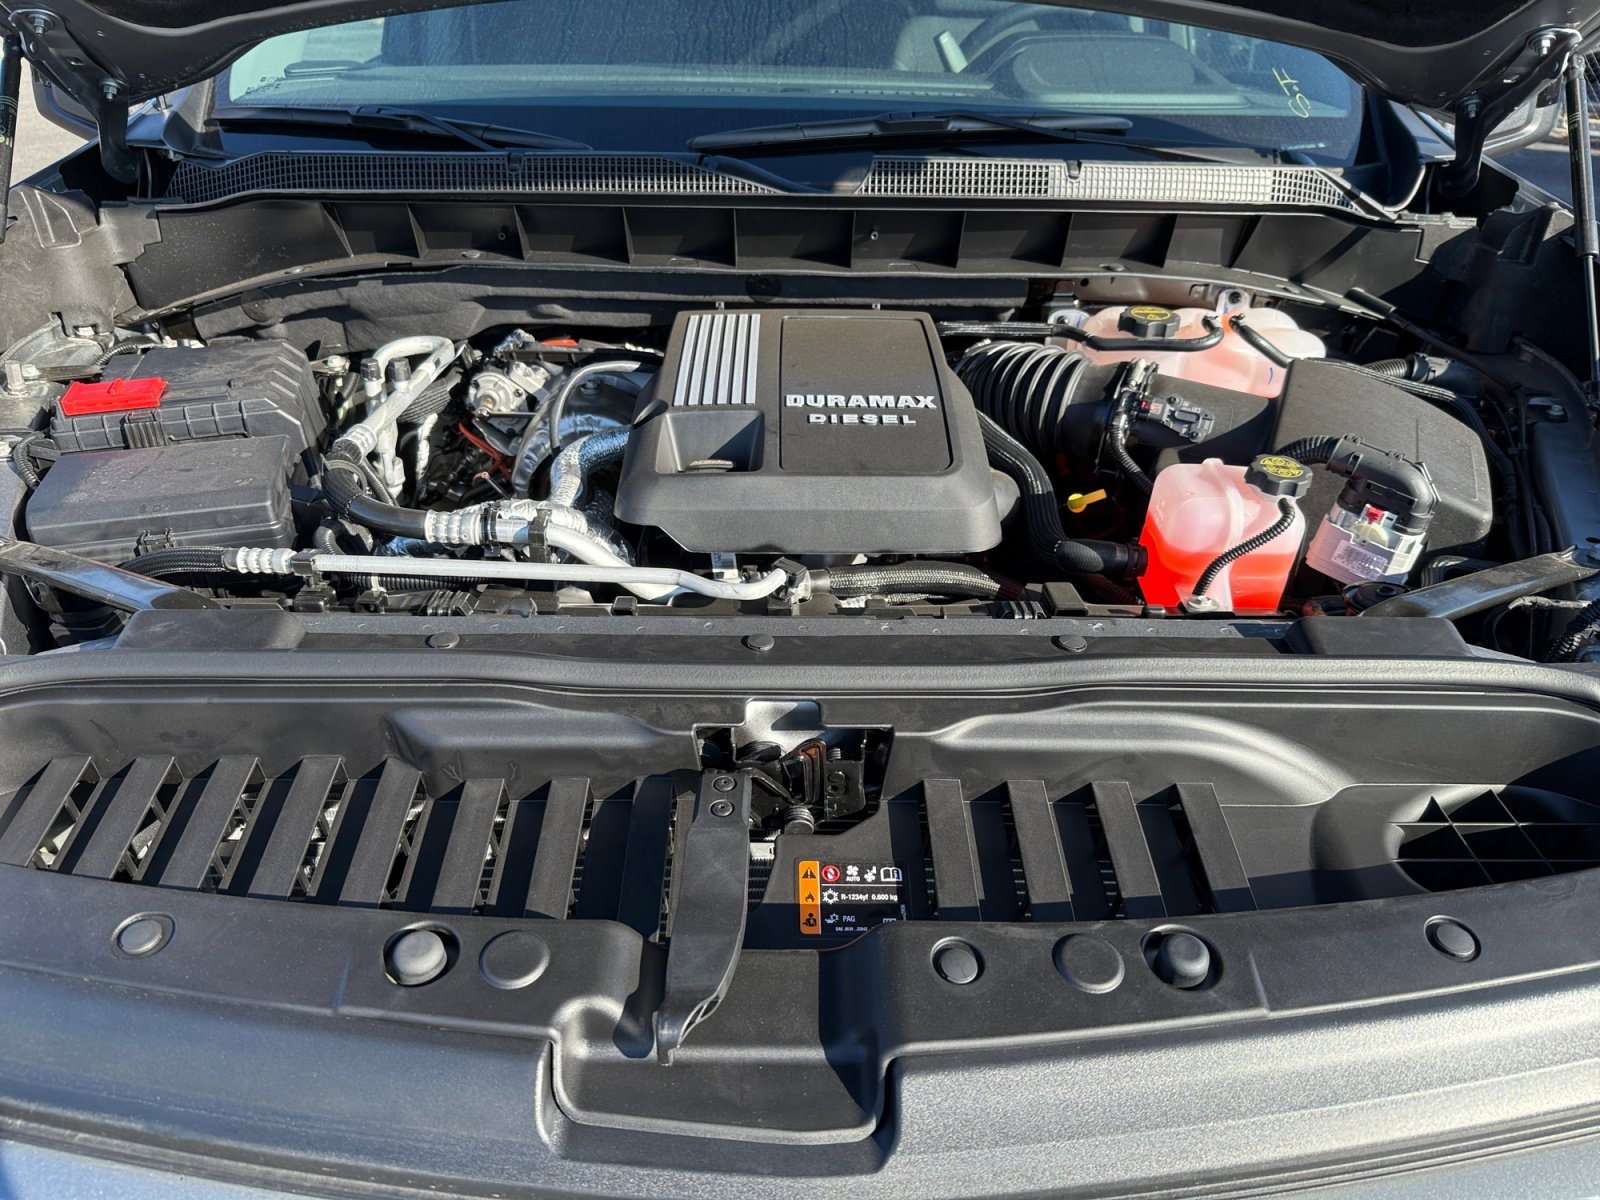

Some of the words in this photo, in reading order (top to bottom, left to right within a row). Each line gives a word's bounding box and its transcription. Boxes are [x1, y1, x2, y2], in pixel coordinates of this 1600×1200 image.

[785, 394, 938, 409] DURAMAX
[809, 413, 917, 426] DIESEL
[841, 893, 869, 902] R-1234yf
[890, 893, 898, 902] kg
